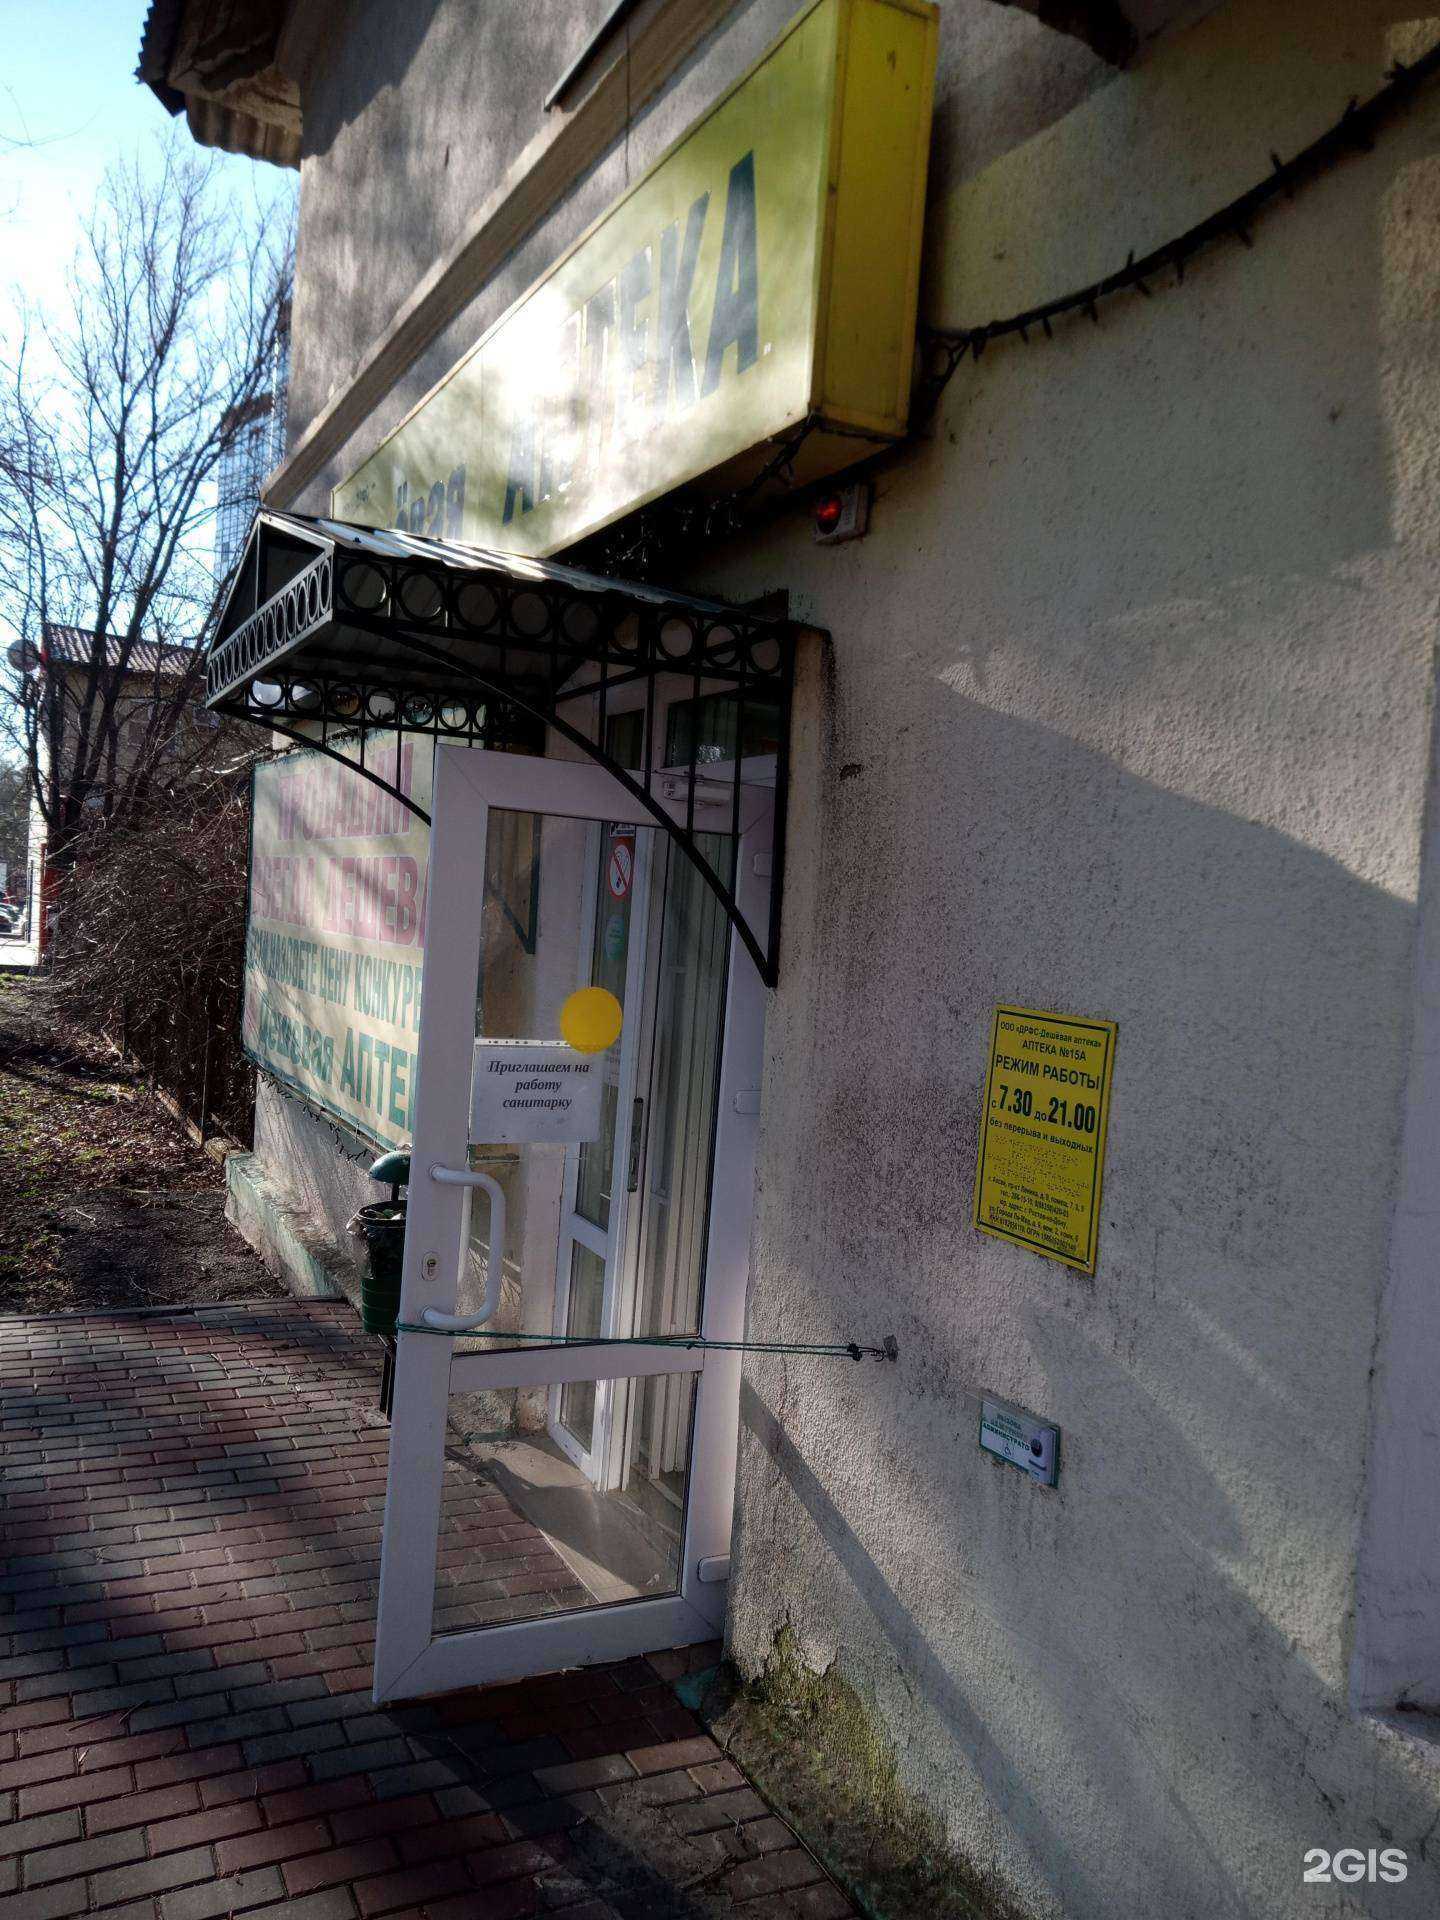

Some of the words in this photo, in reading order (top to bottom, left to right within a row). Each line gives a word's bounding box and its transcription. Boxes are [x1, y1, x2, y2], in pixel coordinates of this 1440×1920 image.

[321, 856, 428, 948] ДЕШЕВ
[1022, 1039, 1057, 1056] АПТЕКА
[488, 1060, 571, 1075] Приглашаем
[574, 1064, 591, 1073] на
[995, 1054, 1040, 1077] РЕЖИМ
[1042, 1064, 1100, 1090] РАБОТЫ
[515, 1078, 561, 1093] работу
[502, 1099, 572, 1111] санитарку
[1000, 1084, 1033, 1117] 7.30
[1034, 1110, 1047, 1122] до
[1048, 1096, 1096, 1134] 21.00
[990, 1116, 1002, 1128] без
[1003, 1122, 1041, 1140] перерыва
[1050, 1134, 1094, 1154] выходных
